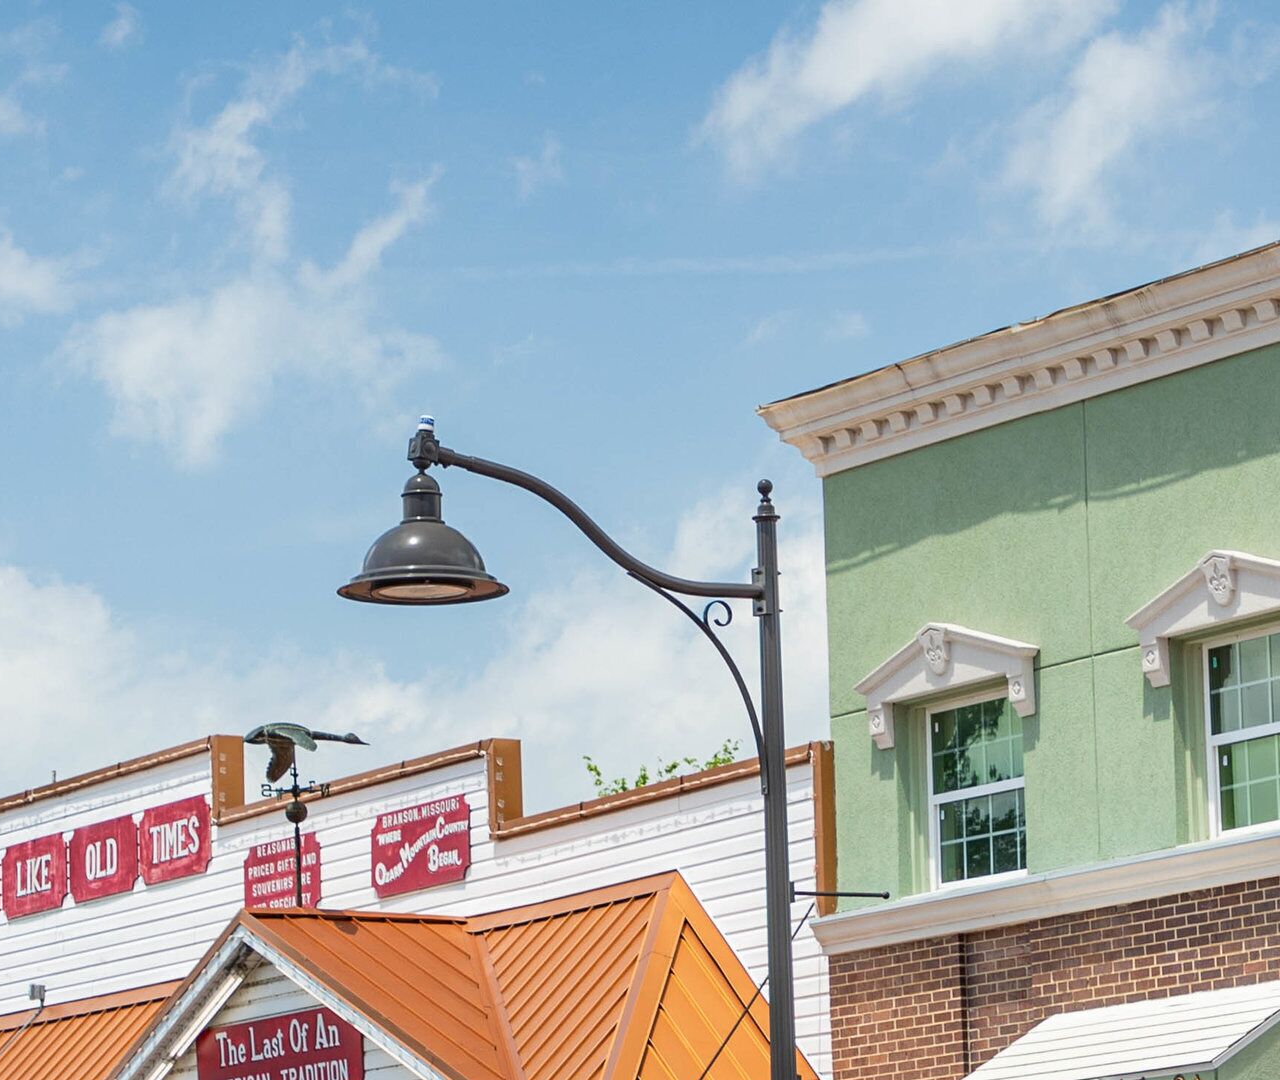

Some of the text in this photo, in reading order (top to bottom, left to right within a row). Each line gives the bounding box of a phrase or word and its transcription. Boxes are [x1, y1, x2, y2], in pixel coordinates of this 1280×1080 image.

[422, 797, 460, 819] MISSOURI
[16, 853, 52, 898] LIKE
[85, 837, 118, 881] OLD
[149, 814, 200, 865] TIMES
[257, 836, 306, 858] REASONABY
[248, 862, 275, 880] PRICED
[302, 852, 317, 866] AND
[252, 876, 294, 897] SOUVENIRS
[270, 893, 312, 908] SPECIATY
[215, 1013, 340, 1068] The Last Of An
